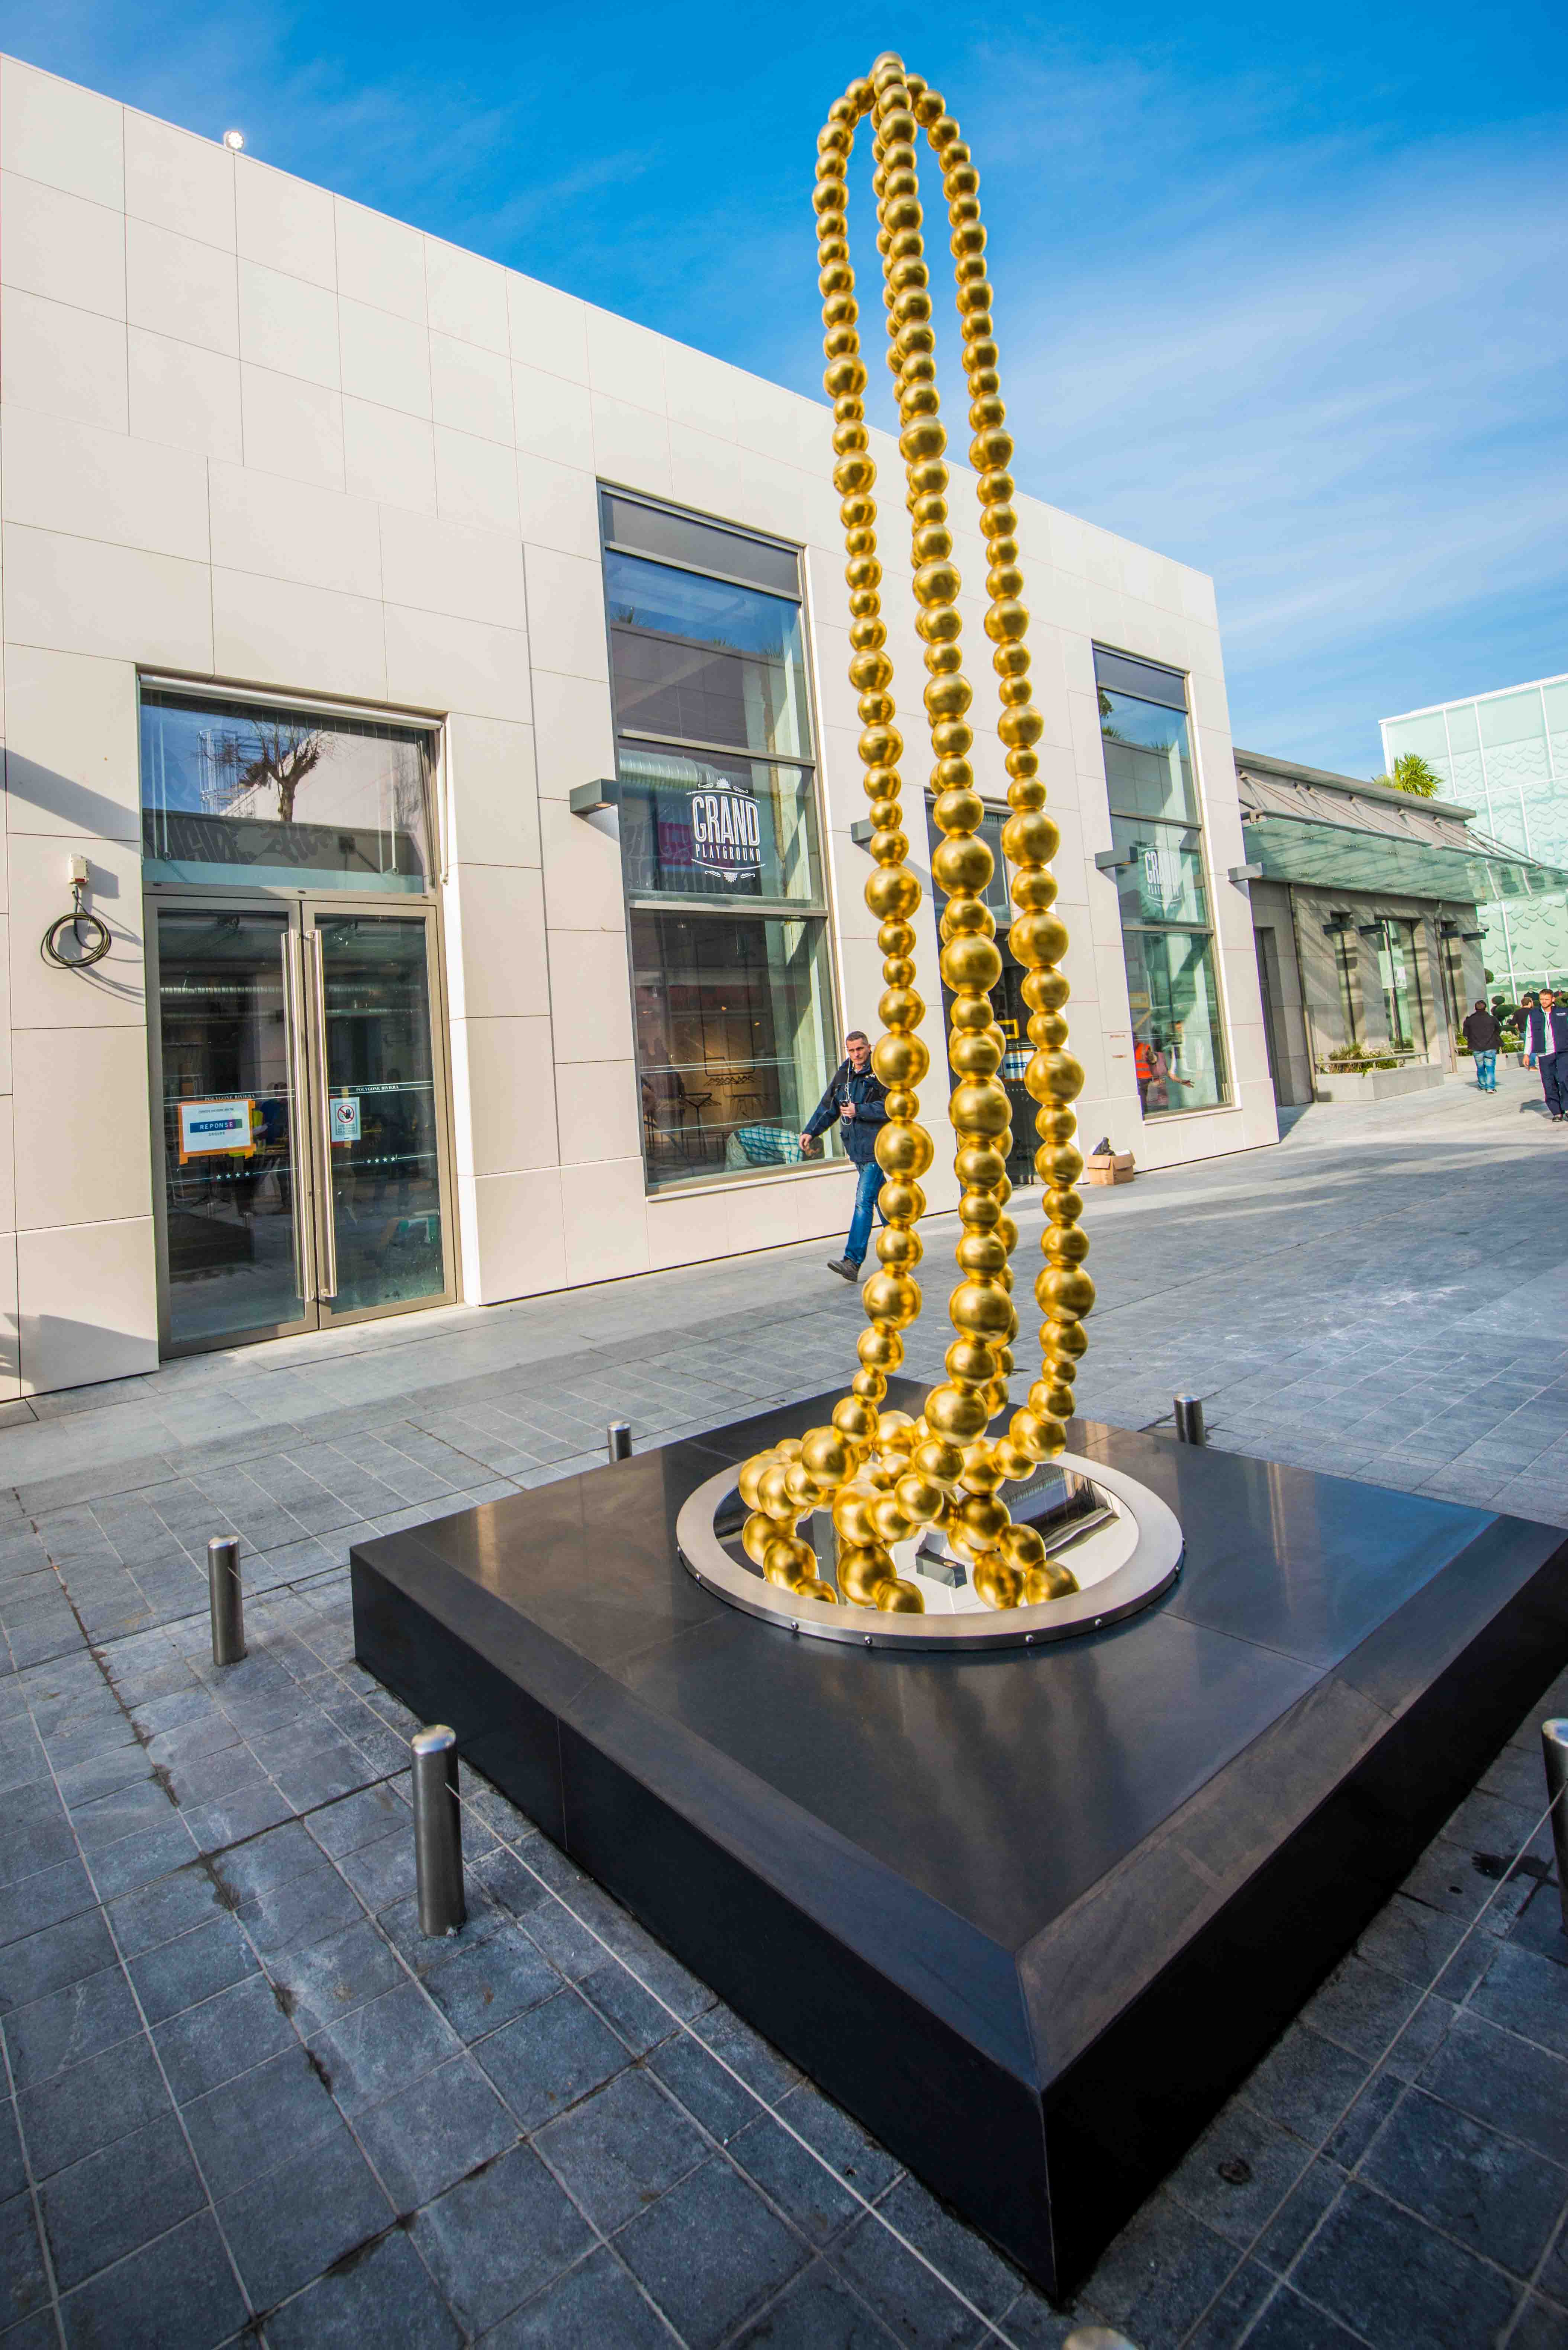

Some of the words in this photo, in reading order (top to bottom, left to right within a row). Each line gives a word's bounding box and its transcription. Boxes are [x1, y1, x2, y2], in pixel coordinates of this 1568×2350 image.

[692, 796, 760, 846] GRAND
[696, 843, 761, 862] PLAYGROUND
[200, 1122, 233, 1130] REPONSE
